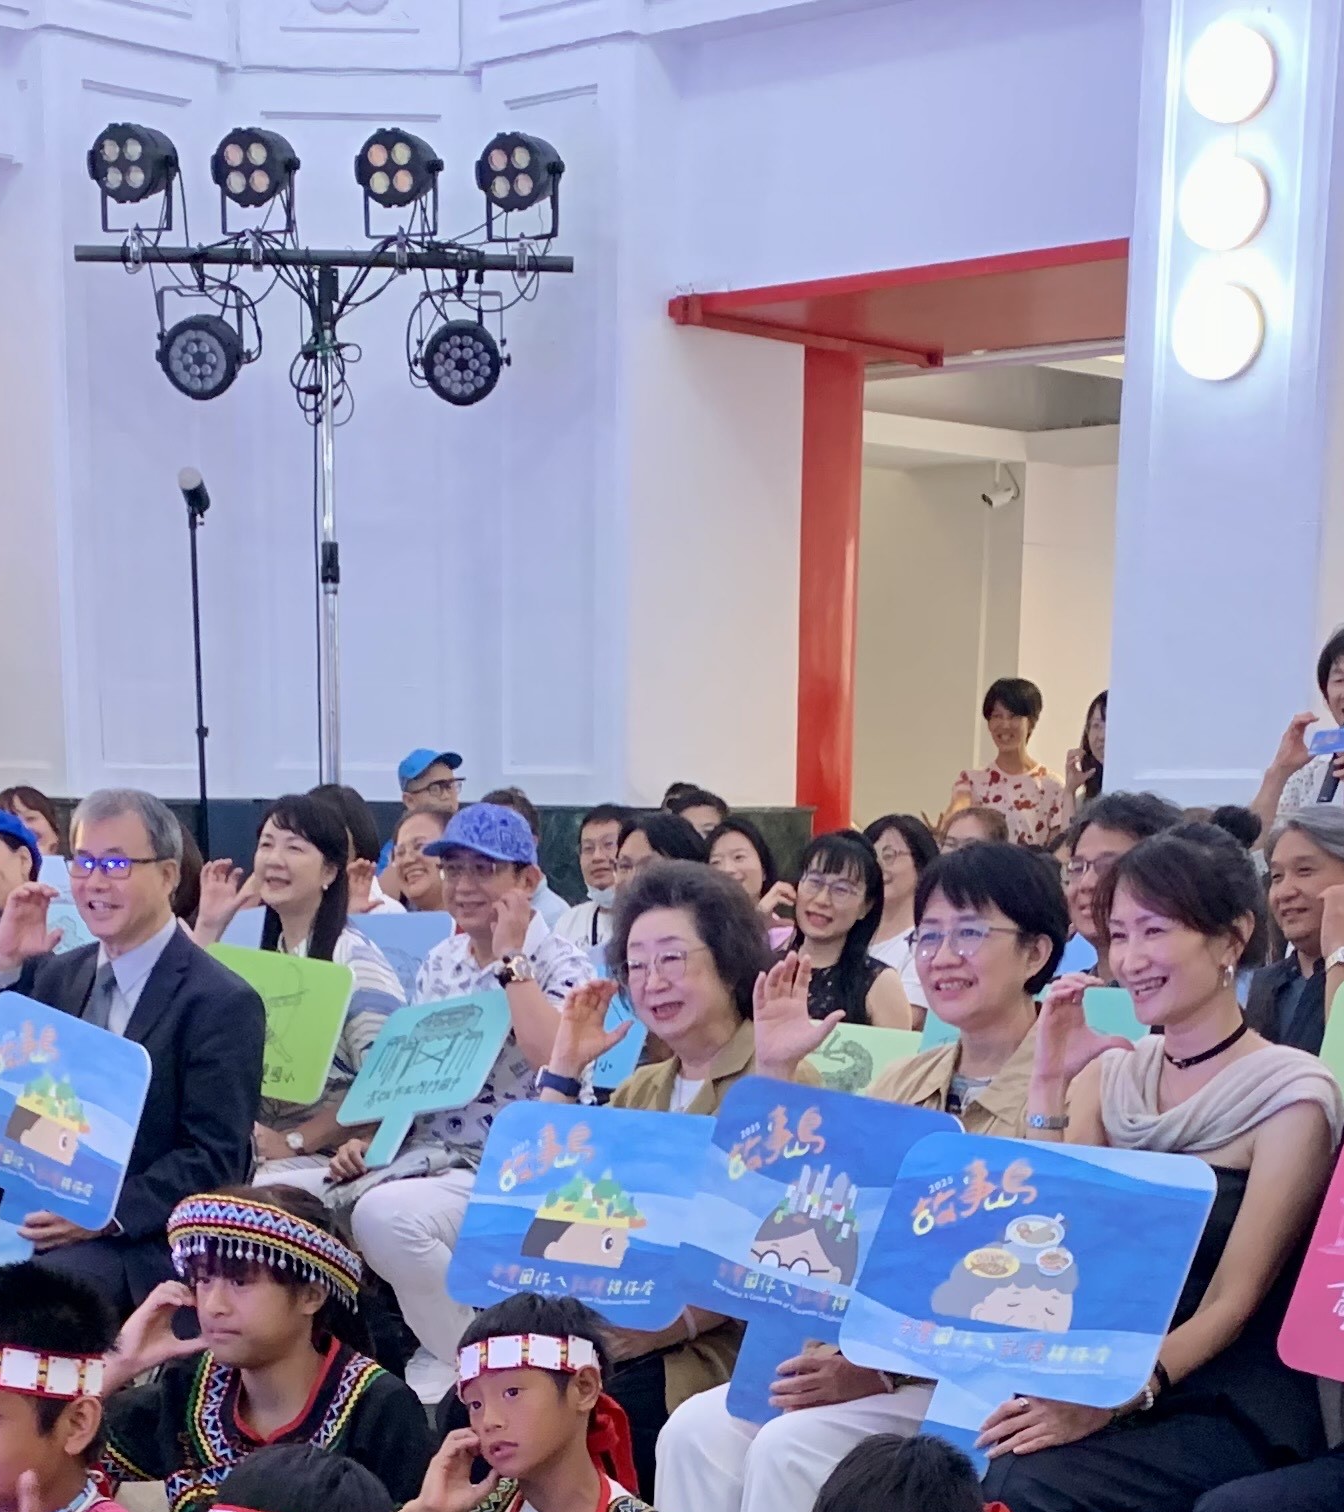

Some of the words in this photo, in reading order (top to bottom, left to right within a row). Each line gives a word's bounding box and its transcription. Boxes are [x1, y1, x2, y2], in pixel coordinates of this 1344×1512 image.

[911, 1158, 1038, 1237] 故事島
[928, 1175, 954, 1195] 2025
